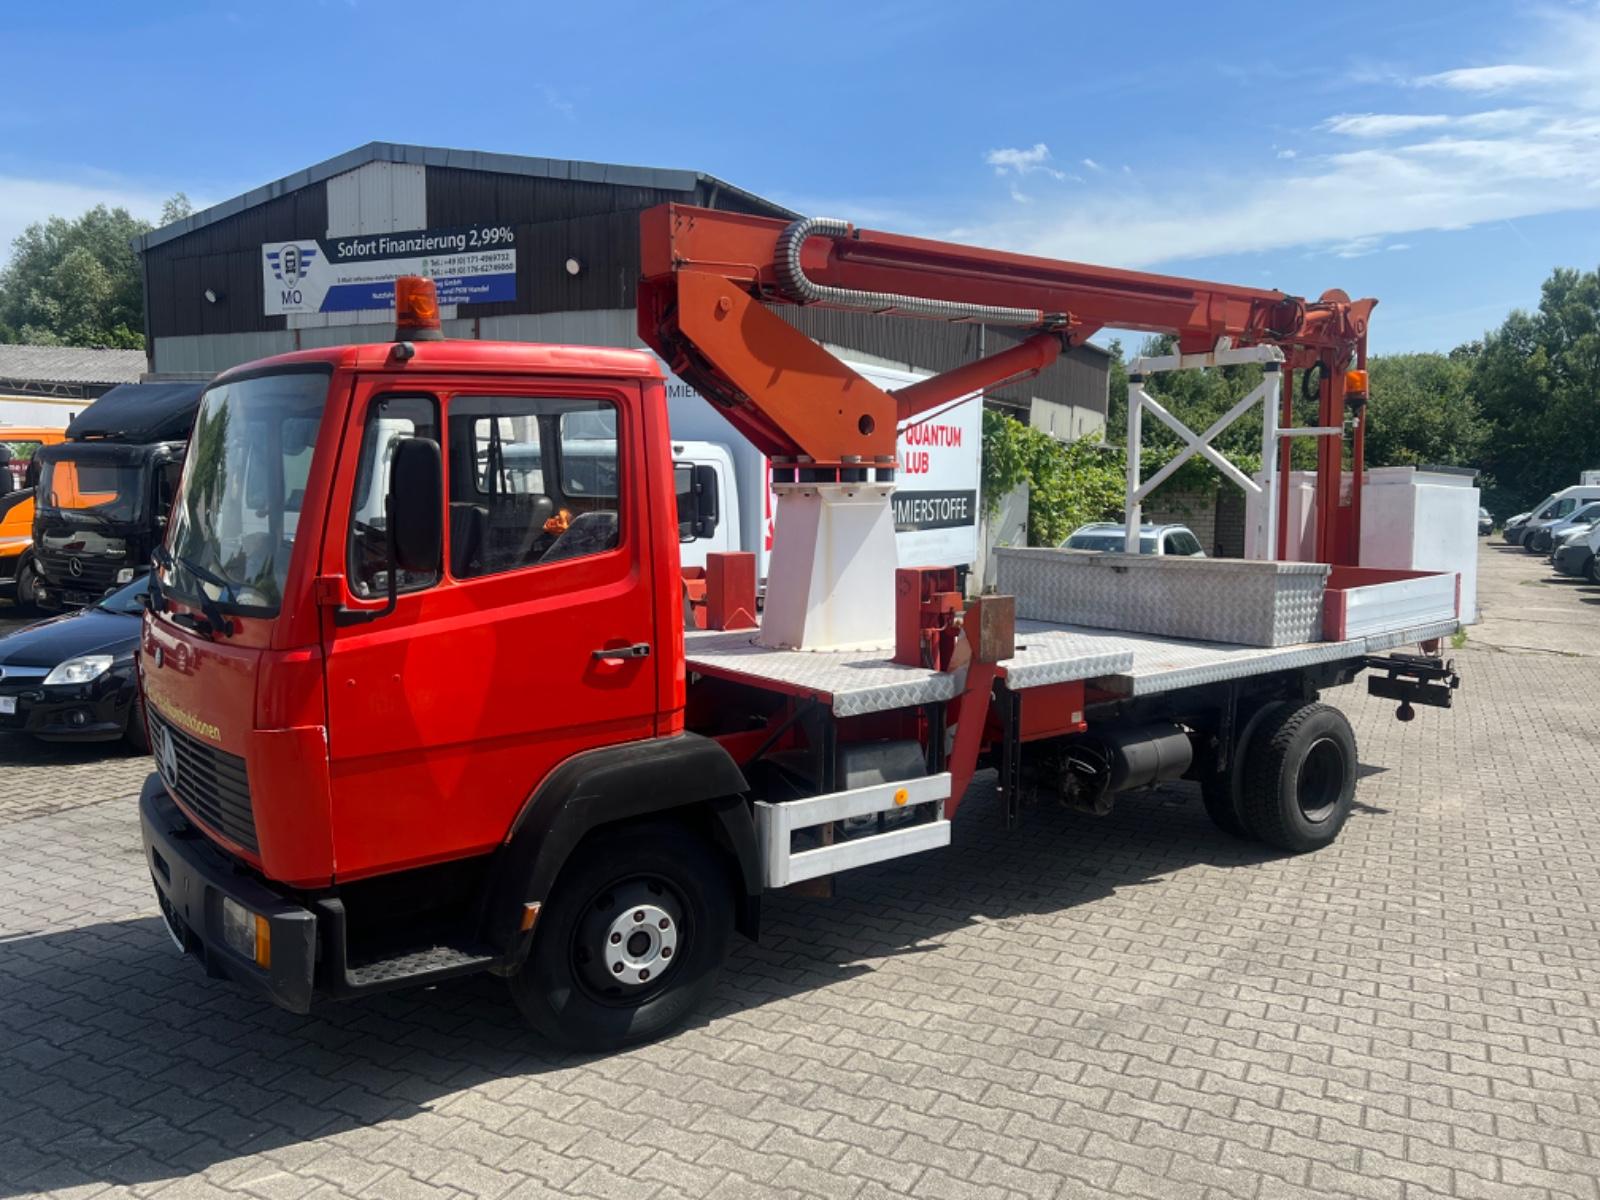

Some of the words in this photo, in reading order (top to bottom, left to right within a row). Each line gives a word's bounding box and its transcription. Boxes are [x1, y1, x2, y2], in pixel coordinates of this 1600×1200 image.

[338, 240, 376, 258] Sofort
[380, 234, 466, 253] Finanzierung
[469, 226, 514, 247] 2,99%
[281, 290, 302, 304] MO
[906, 423, 961, 447] QUANTUM
[905, 451, 929, 474] LUB
